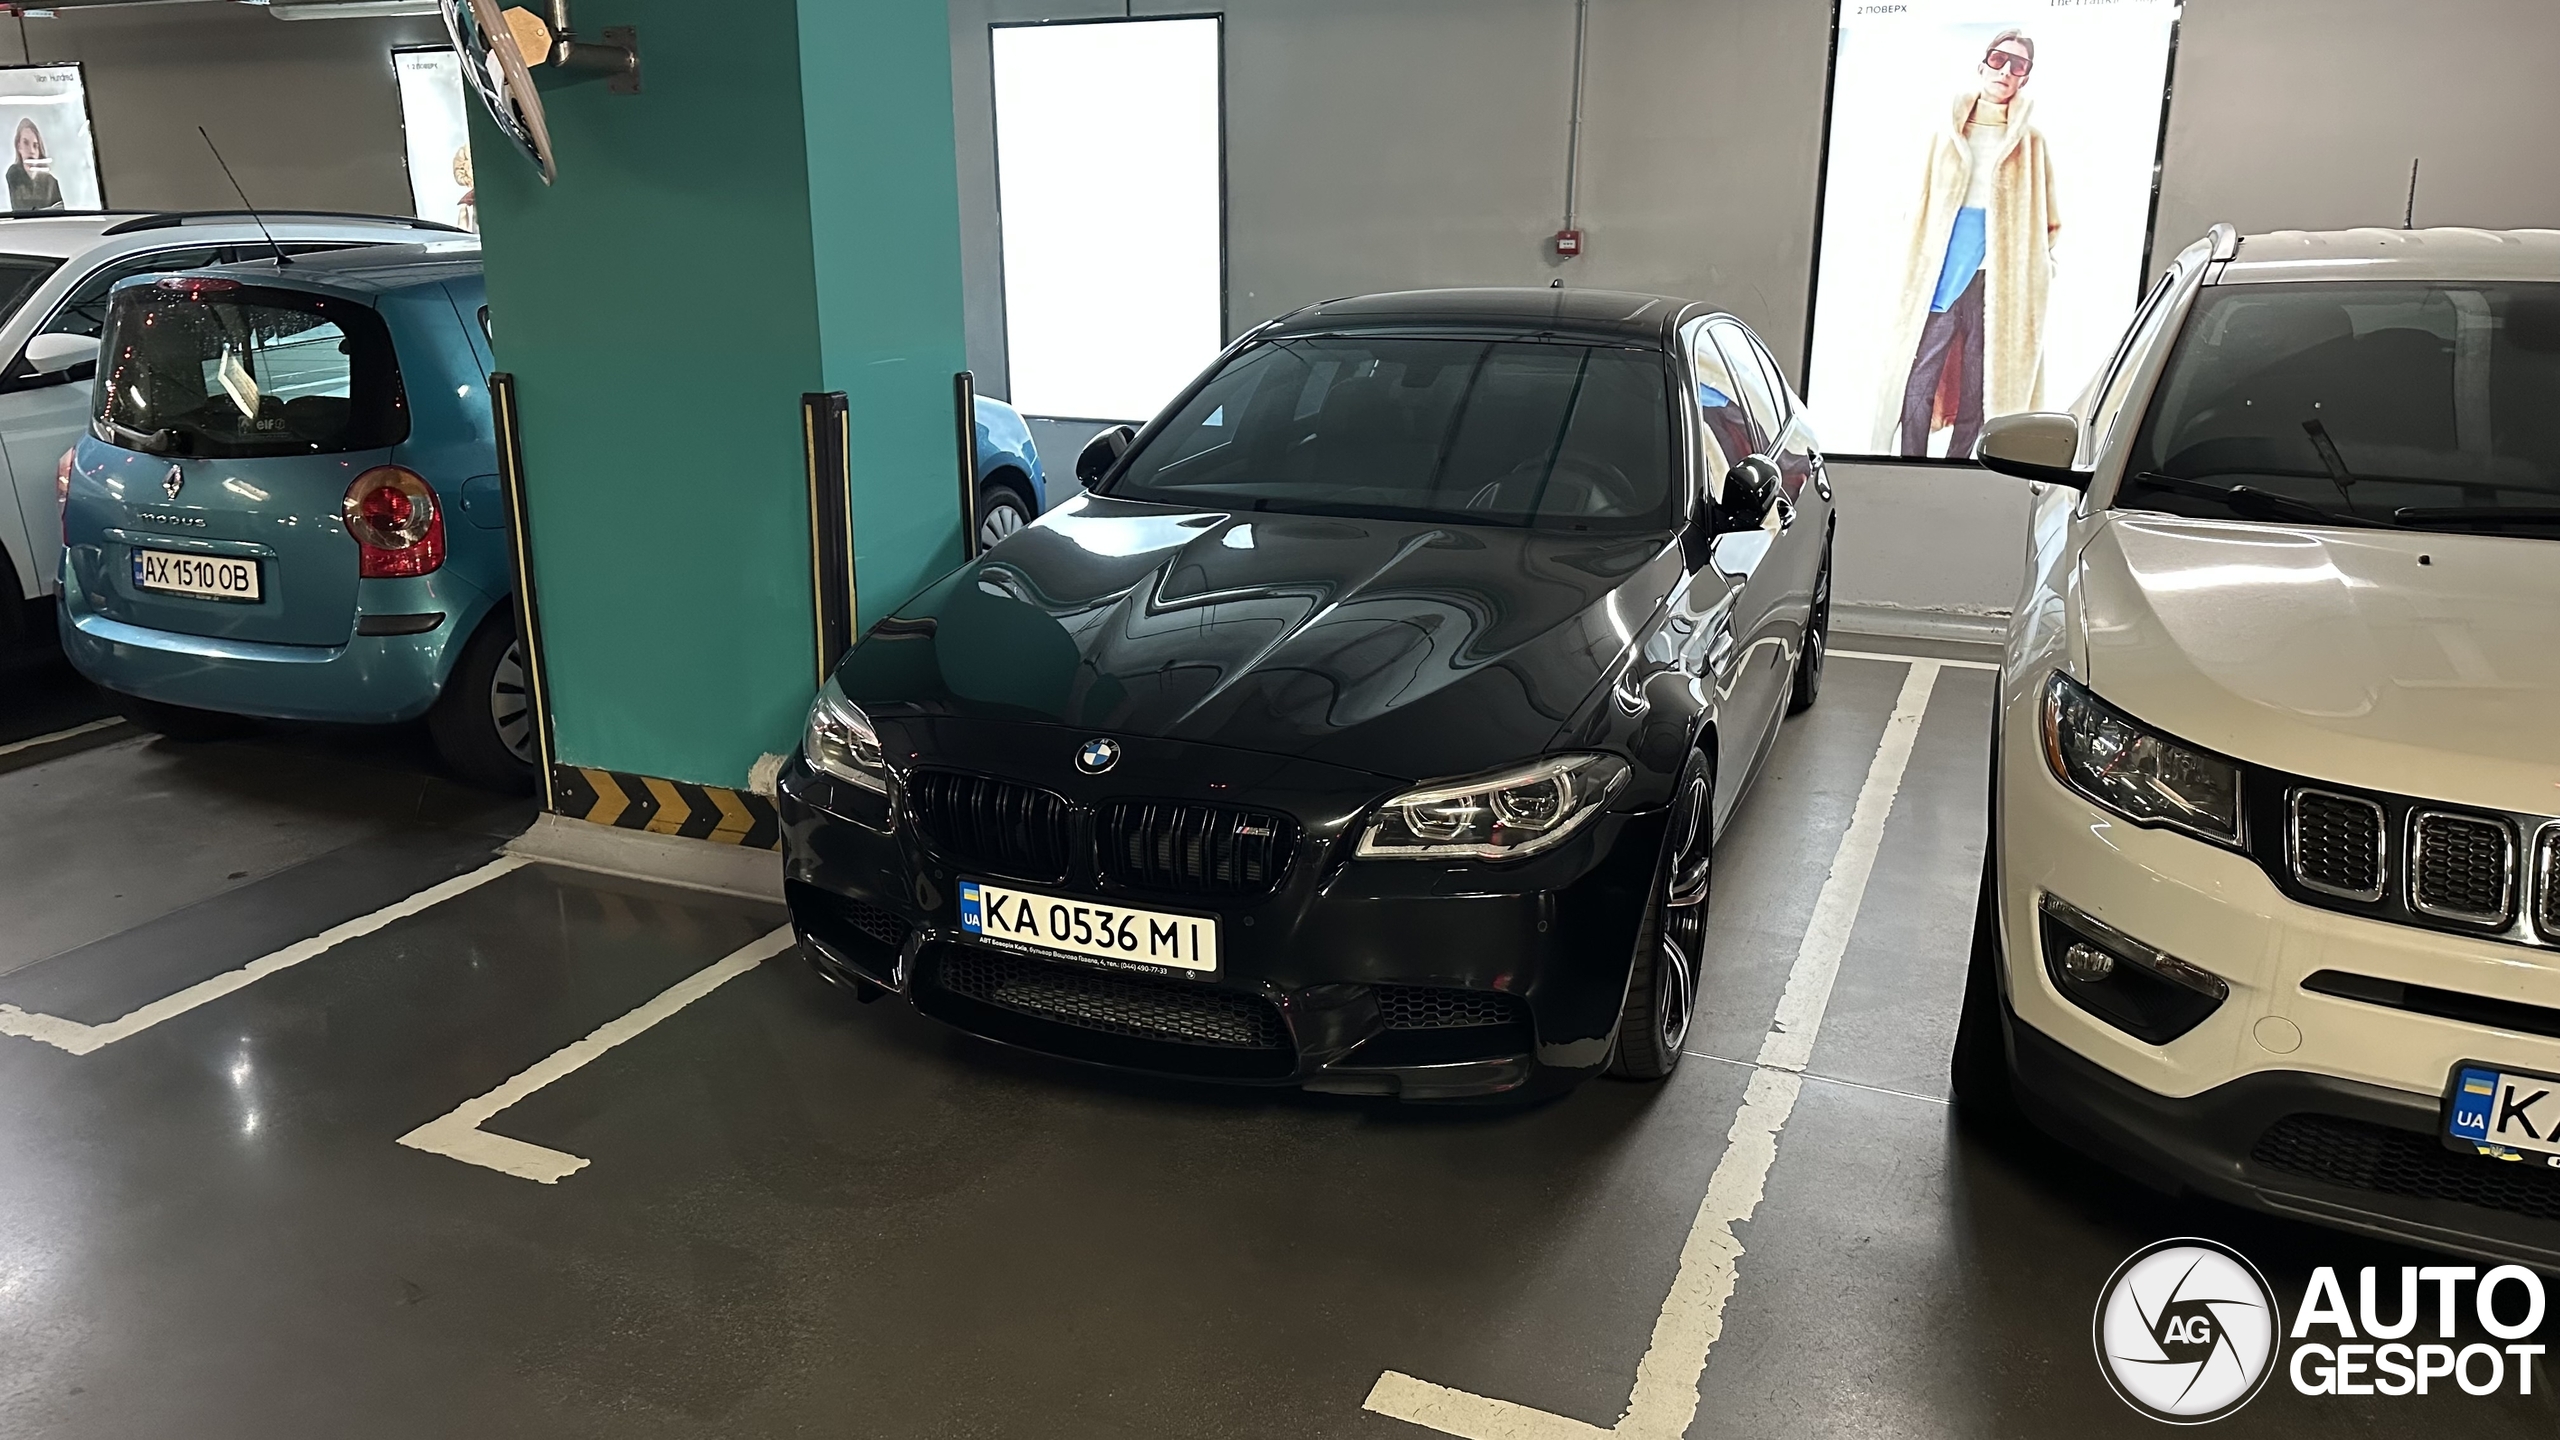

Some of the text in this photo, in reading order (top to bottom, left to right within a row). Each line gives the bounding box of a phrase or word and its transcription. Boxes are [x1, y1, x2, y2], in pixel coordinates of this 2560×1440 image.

[1857, 4, 1907, 15] 2 ПОВЕРХ
[256, 419, 274, 431] elf
[145, 556, 249, 591] AX 1510 OB
[963, 912, 981, 927] UA
[985, 891, 1199, 961] KA 0536 MI
[1120, 962, 1137, 971] (044)
[1137, 964, 1168, 975] 490-77-33
[2457, 1110, 2485, 1130] UA
